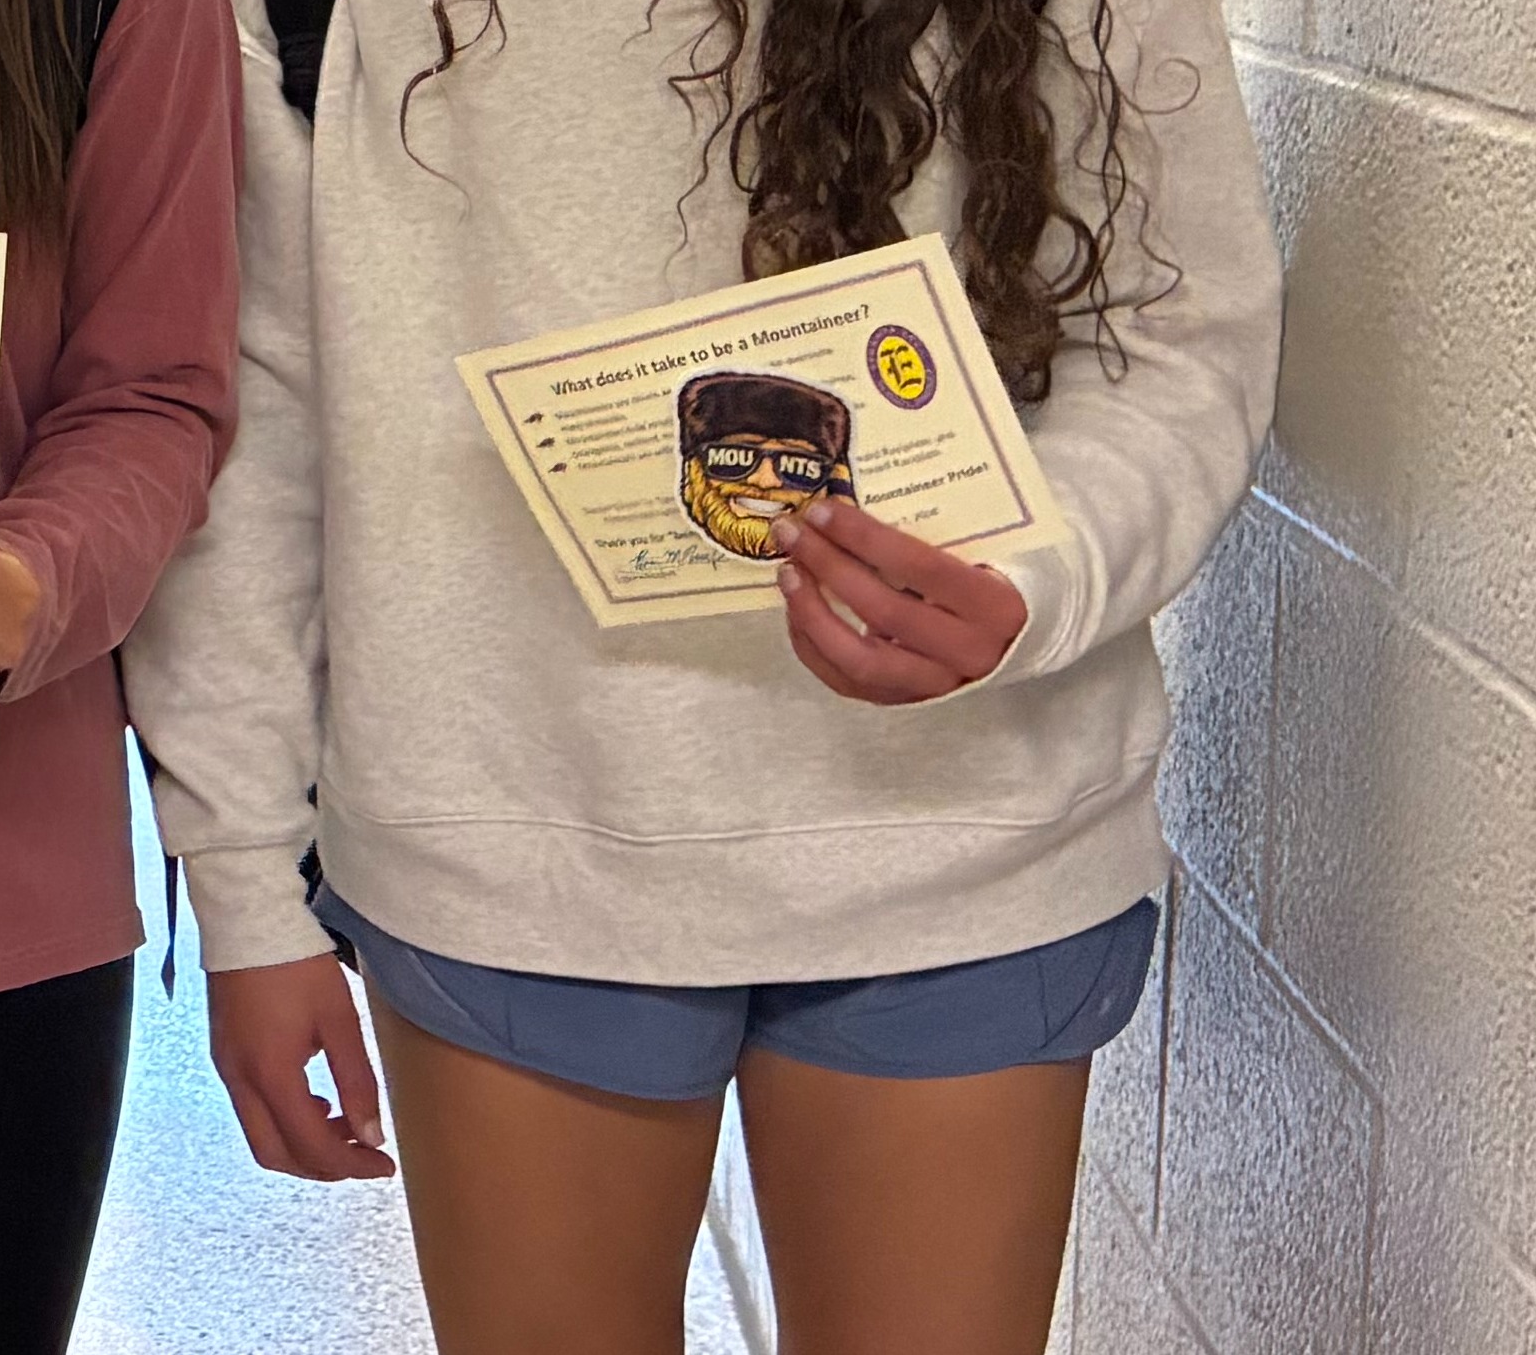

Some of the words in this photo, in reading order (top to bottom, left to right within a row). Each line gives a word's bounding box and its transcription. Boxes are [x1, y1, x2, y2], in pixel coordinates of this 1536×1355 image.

[550, 376, 593, 396] What
[596, 370, 633, 387] does
[635, 364, 648, 378] it
[651, 355, 686, 374] take
[690, 350, 708, 364] to
[713, 342, 733, 357] be
[738, 340, 748, 350] a
[752, 304, 870, 346] Mountaineer?
[707, 448, 754, 468] MOU
[780, 457, 821, 480] NTS
